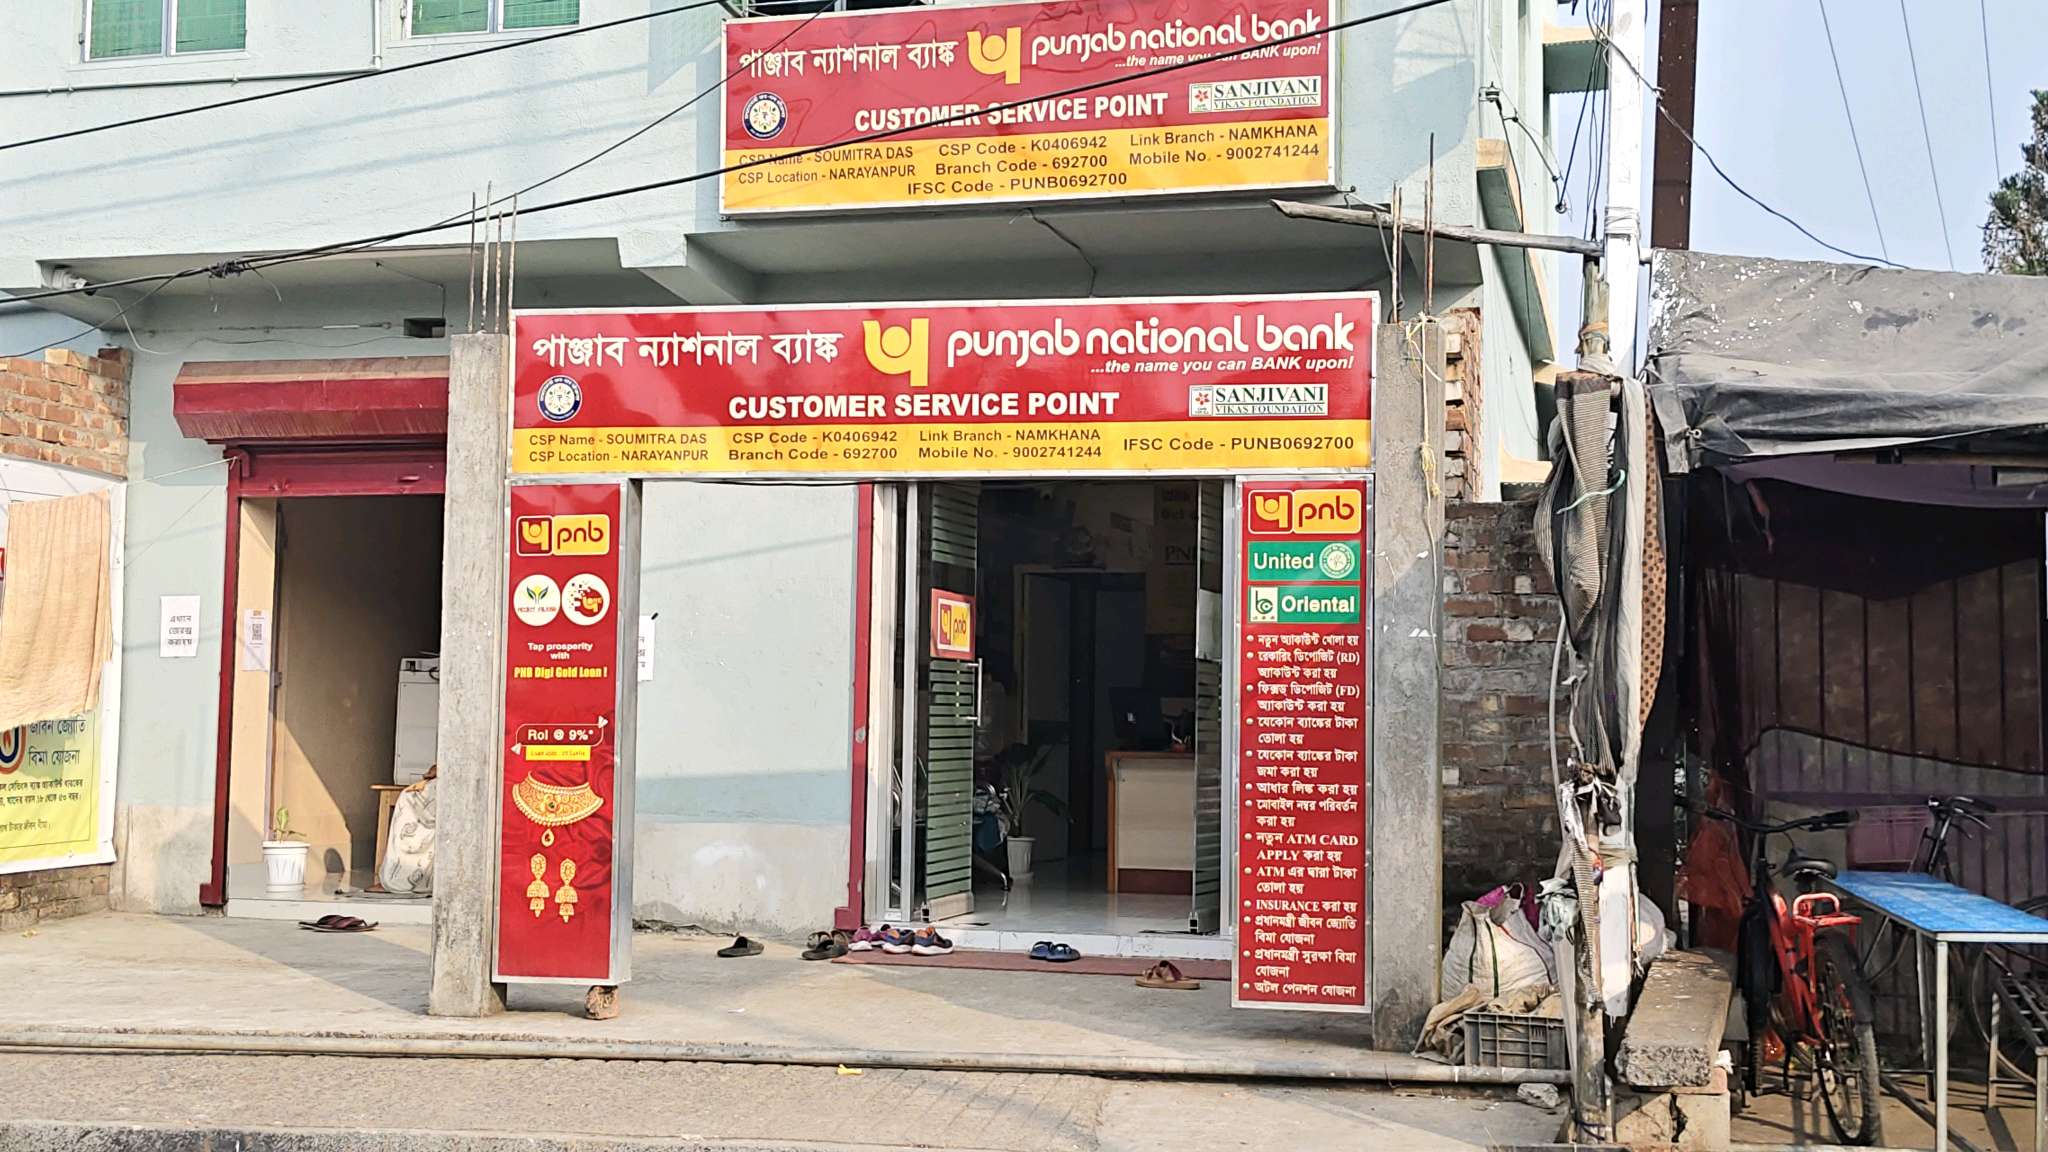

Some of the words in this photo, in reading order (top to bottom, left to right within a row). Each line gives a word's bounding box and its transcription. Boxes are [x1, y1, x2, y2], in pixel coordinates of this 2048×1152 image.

[1032, 23, 1125, 64] punjab
[1131, 15, 1246, 49] national
[1252, 9, 1321, 43] bank
[739, 49, 806, 78] পাঞ্জাব
[812, 42, 900, 73] ন্যাশনাল
[906, 39, 959, 68] ব্যাঙ্ক
[1115, 55, 1146, 67] ...the
[1150, 53, 1184, 66] name
[1188, 54, 1210, 65] you
[1241, 46, 1280, 59] BANK
[1283, 43, 1321, 57] upon!
[1214, 79, 1318, 98] SANJIVANI
[1214, 99, 1246, 109] VIKAS
[1249, 96, 1318, 107] FOUNDATION
[855, 104, 981, 131] CUSTOMER
[988, 98, 1088, 125] SERVICE
[1095, 93, 1168, 118] POINT
[1131, 132, 1159, 146] Link
[1166, 131, 1214, 144] Branch
[1229, 125, 1318, 140] NAMKHANA
[939, 143, 971, 156] CSP
[977, 142, 1016, 154] Code
[1031, 136, 1107, 151] K0406942
[814, 148, 881, 162] SOUMITRA
[887, 147, 913, 159] DAS
[1130, 152, 1180, 165] Mobile
[1226, 144, 1319, 160] 9002741244
[936, 161, 991, 175] Branch
[997, 159, 1036, 174] Code
[1052, 155, 1108, 169] 692700
[739, 172, 763, 184] CSP
[768, 171, 817, 183] Location
[829, 165, 915, 180] NARAYANPUR
[908, 182, 945, 195] IFSC
[951, 180, 994, 193] Code
[1010, 172, 1128, 190] PUNB0692700
[947, 316, 1080, 368] punjab
[1086, 315, 1248, 354] national
[1257, 312, 1354, 351] bank
[533, 332, 630, 367] পাঞ্জাব
[636, 330, 762, 366] ন্যাশনাল
[770, 329, 844, 365] ব্যাঙ্ক
[1091, 359, 1130, 374] ...the
[1134, 360, 1177, 372] name
[1181, 359, 1211, 375] you
[1216, 358, 1246, 371] can
[1251, 357, 1301, 370] BANK
[1305, 356, 1354, 371] upon!
[1215, 386, 1324, 403] SANJIVANI
[728, 395, 886, 420] CUSTOMER
[895, 393, 1019, 417] SERVICE
[1028, 392, 1119, 415] POINT
[1215, 405, 1248, 414] VIKAS
[1252, 404, 1324, 414] FOUNDATION
[530, 434, 555, 446] CSP
[560, 434, 595, 445] Name
[607, 433, 676, 445] SOUMITRA
[680, 433, 707, 444] DAS
[732, 433, 764, 444] CSP
[769, 432, 807, 443] Code
[822, 431, 897, 442] K0406942
[920, 430, 948, 441] Link
[953, 430, 1002, 441] Branch
[1016, 429, 1100, 441] NAMKHANA
[1124, 438, 1162, 451] IFSC
[1169, 437, 1213, 450] Code
[1231, 436, 1354, 450] PUNB0692700
[530, 451, 555, 462] CSP
[559, 450, 610, 462] Location
[622, 449, 708, 461] NARAYANPUR
[729, 449, 783, 461] Branch
[788, 449, 828, 460] Code
[844, 447, 897, 459] 692700
[919, 447, 968, 458] Mobile
[1013, 446, 1102, 458] 9002741244
[1299, 496, 1355, 528] pnb
[557, 520, 604, 549] pnb
[1254, 553, 1314, 569] United
[1281, 595, 1354, 613] Oriental
[528, 643, 544, 652] Tap
[546, 642, 593, 652] prosperity
[1257, 634, 1278, 648] নতুন
[1322, 634, 1344, 645] খোলা
[1347, 634, 1359, 645] হয়
[551, 652, 570, 660] with
[1294, 648, 1335, 662] ডিপোজিট
[1337, 651, 1360, 665] (RD)
[514, 667, 533, 678] PNB
[534, 667, 554, 679] Digi
[555, 667, 578, 678] Gold
[579, 667, 601, 678] Loan
[1303, 668, 1321, 678] করা
[1323, 668, 1337, 679] হয়
[1290, 681, 1333, 695] ডিপোজিট
[1336, 684, 1360, 698] (FD)
[1307, 701, 1328, 712] করা
[1330, 701, 1346, 712] হয়
[1257, 717, 1294, 728] যেকোন
[1334, 715, 1358, 728] টাকা
[553, 729, 564, 741] @
[1258, 733, 1287, 744] তোলা
[1288, 734, 1304, 744] হয়
[28, 746, 48, 767] বিমা
[1257, 749, 1294, 760] যেকোন
[1334, 748, 1358, 762] টাকা
[1256, 766, 1278, 777] জমা
[1280, 766, 1300, 777] করা
[1303, 767, 1318, 778] হয়
[1256, 782, 1289, 794] আধার
[1317, 784, 1340, 795] করা
[1342, 784, 1358, 795] হয়
[1256, 797, 1294, 811] মোবাইল
[1319, 797, 1358, 812] পরিবর্তন
[1256, 815, 1277, 827] করা
[1280, 816, 1296, 827] হয়
[1256, 832, 1284, 846] নতুন
[1287, 834, 1316, 845] ATM
[1319, 834, 1358, 845] CARD
[1257, 850, 1299, 860] APPLY
[1303, 850, 1324, 861] করা
[1326, 851, 1343, 862] হয়
[1256, 867, 1285, 877] ATM
[1287, 867, 1305, 877] এর
[1332, 865, 1358, 879] টাকা
[1256, 882, 1286, 893] তোলা
[1288, 883, 1304, 894] হয়
[1256, 900, 1320, 912] INSURANCE
[1321, 901, 1341, 912] করা
[1343, 902, 1357, 912] হয়
[1298, 913, 1323, 928] জীবন
[1326, 915, 1357, 929] জ্যোতি
[1254, 929, 1276, 944] বিমা
[1280, 933, 1315, 944] যোজনা
[1334, 949, 1357, 963] বিমা
[1255, 966, 1290, 977] যোজনা
[1254, 980, 1279, 994] অটল
[1283, 983, 1318, 995] পেনশন
[1321, 985, 1357, 997] যোজনা
